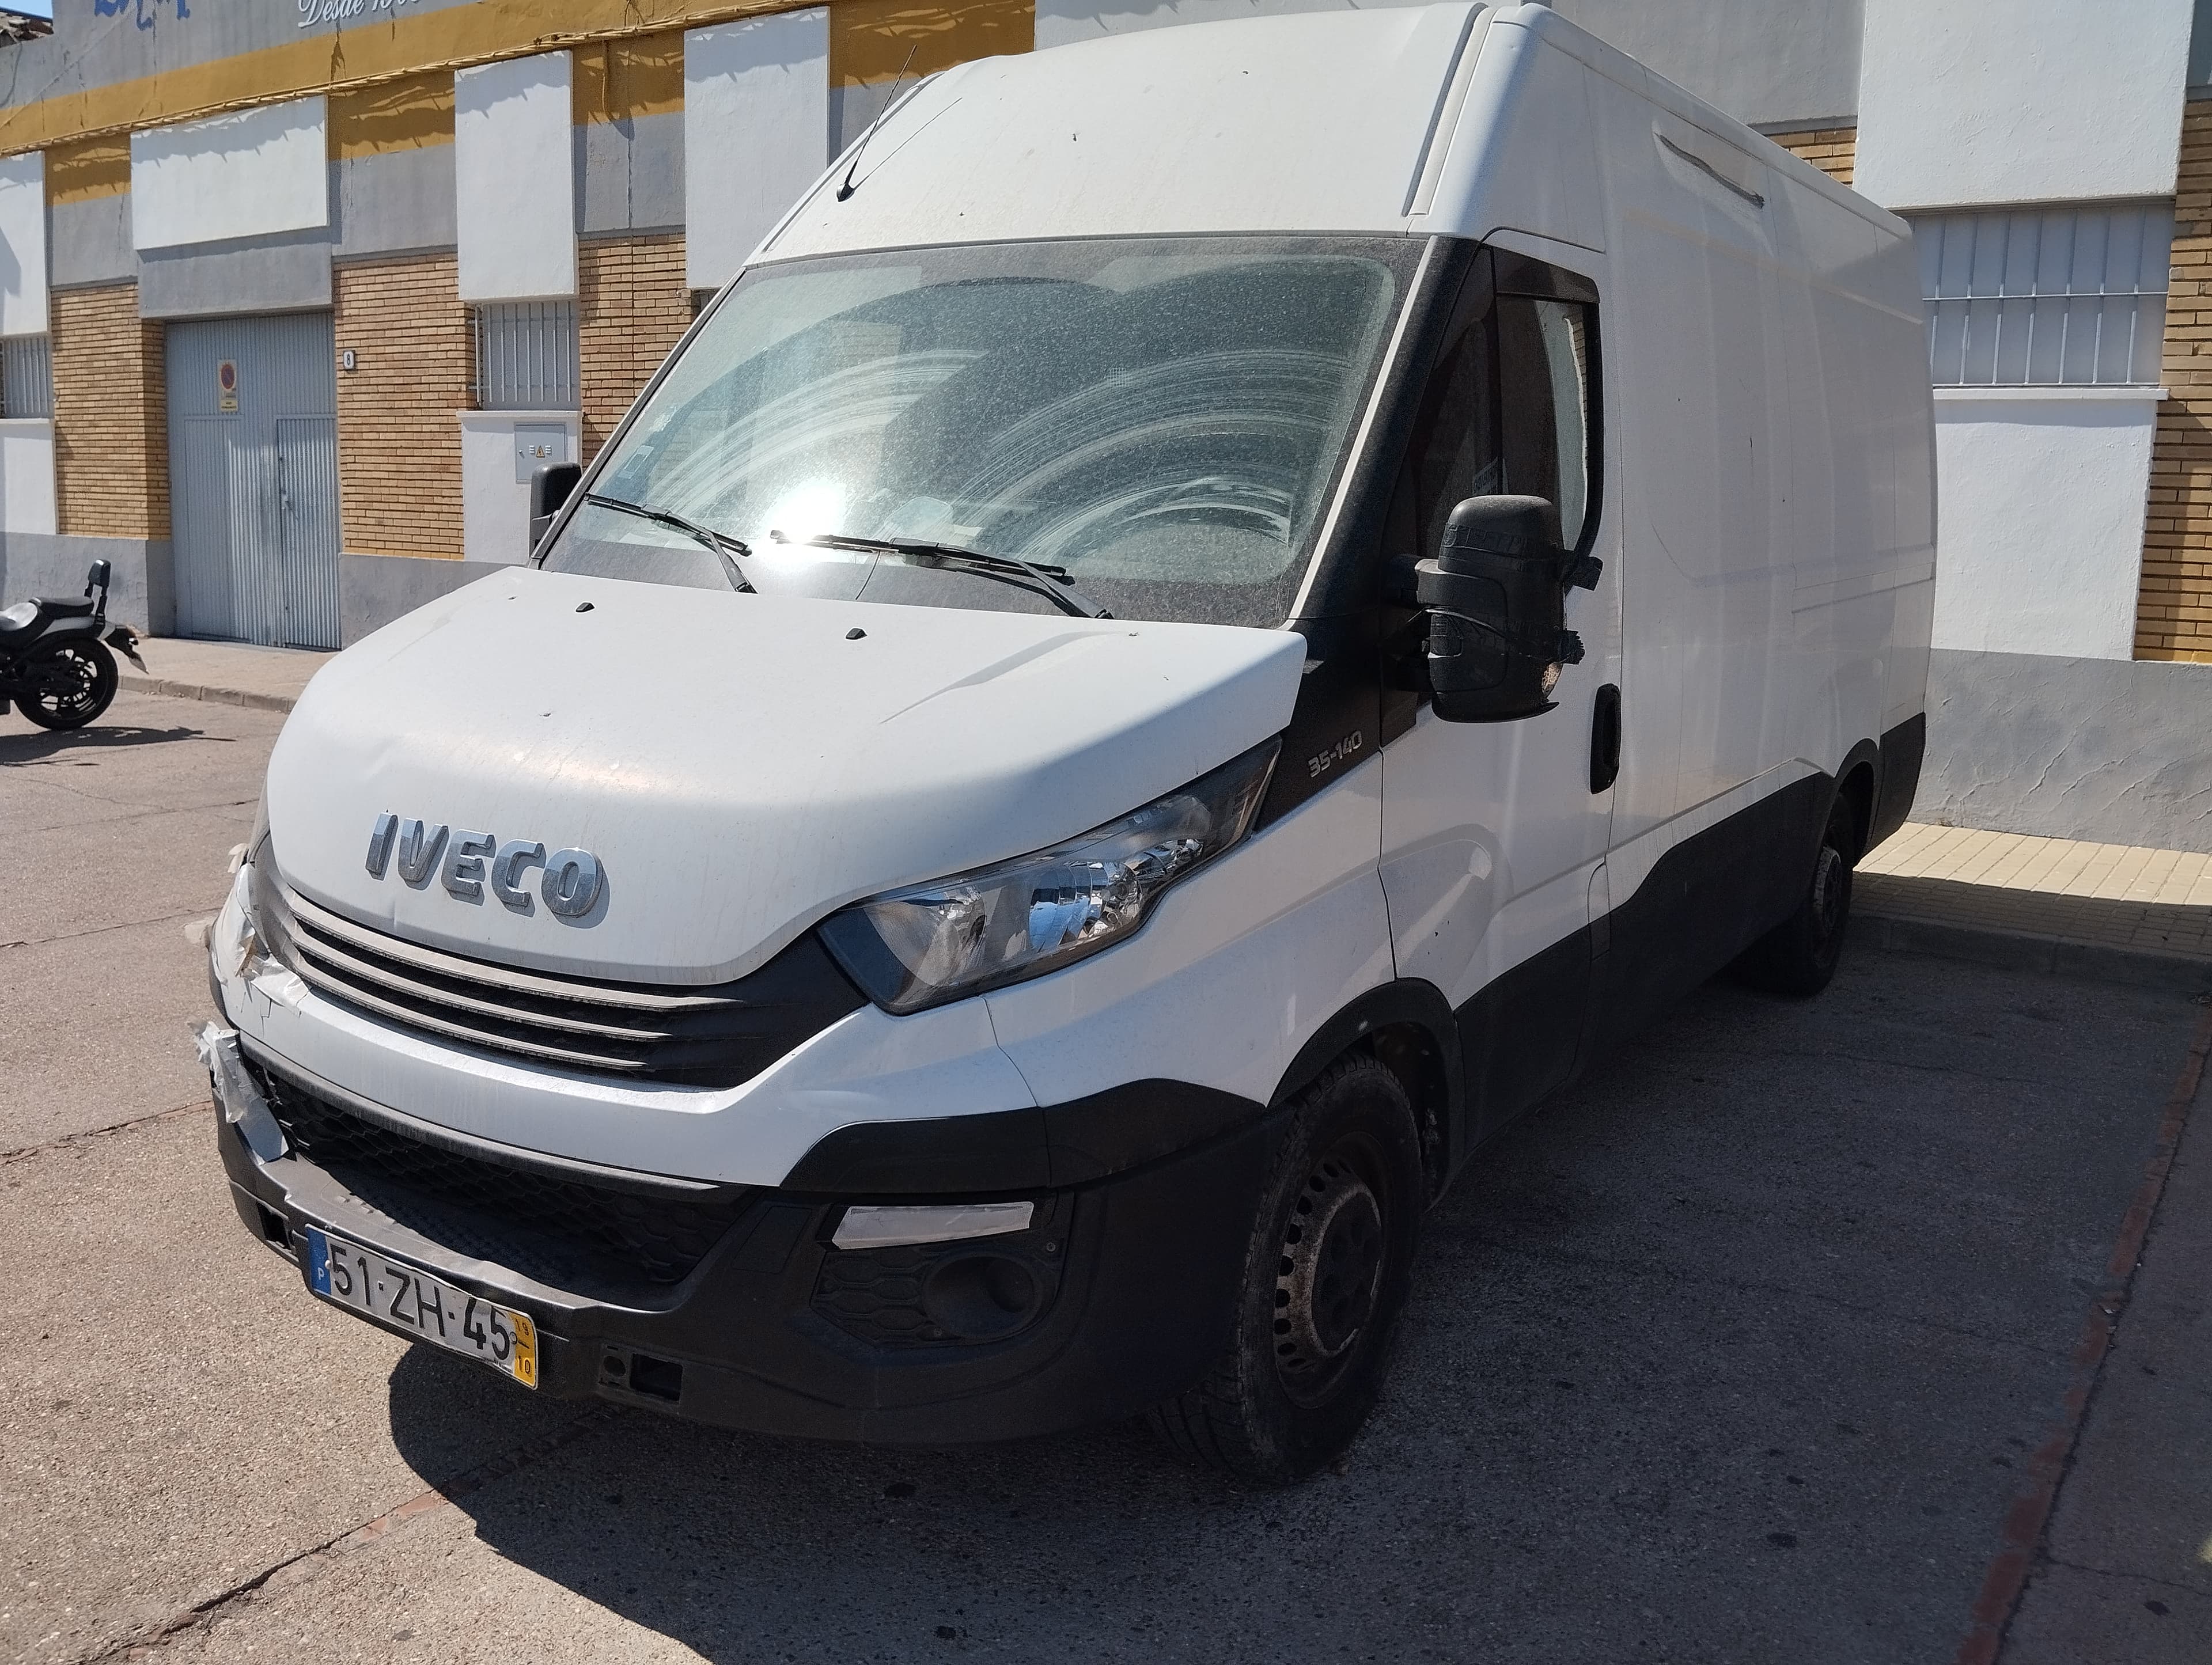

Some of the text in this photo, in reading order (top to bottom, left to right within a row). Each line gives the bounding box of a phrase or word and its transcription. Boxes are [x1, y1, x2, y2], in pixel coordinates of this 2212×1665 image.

[347, 353, 351, 366] 8
[1308, 730, 1363, 777] 35-140
[365, 812, 604, 919] IVECO
[317, 1266, 324, 1280] P
